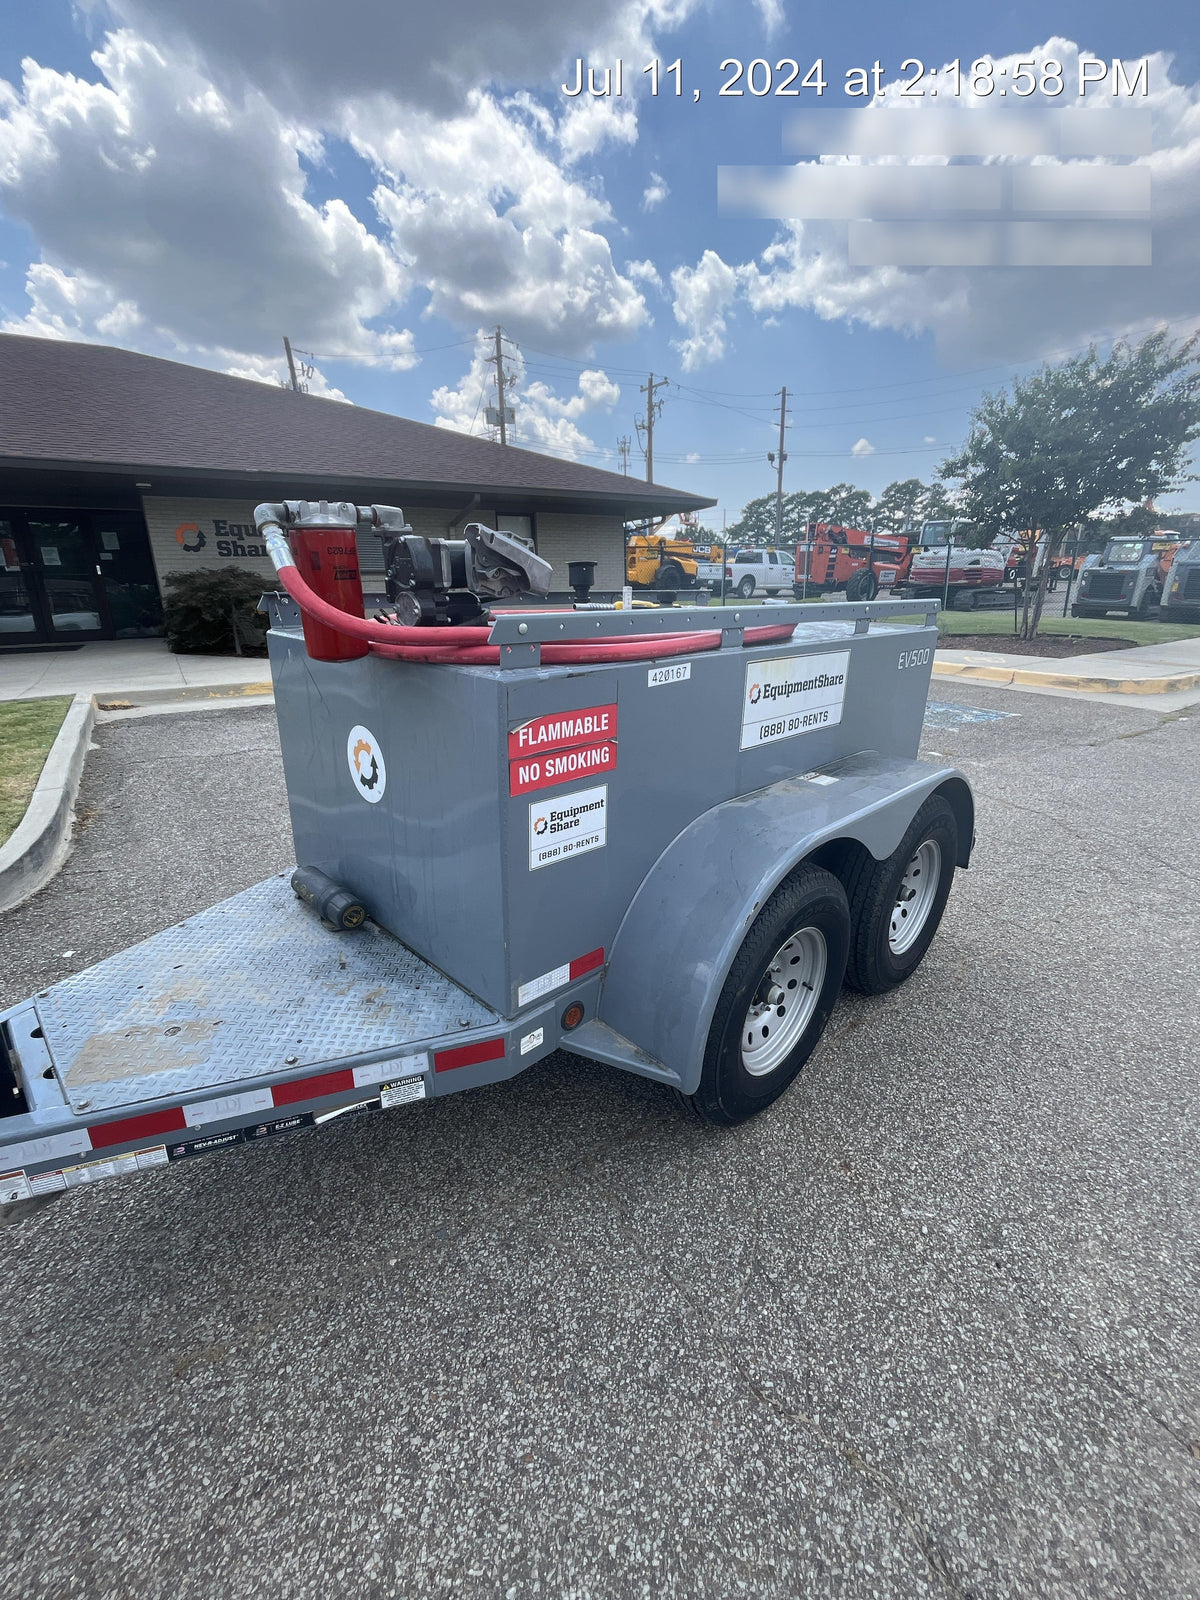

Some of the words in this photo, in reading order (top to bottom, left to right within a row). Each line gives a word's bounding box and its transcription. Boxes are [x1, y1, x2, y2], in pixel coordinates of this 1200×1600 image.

[217, 541, 268, 557] Shar
[692, 545, 712, 554] JCB
[897, 647, 930, 670] EV500
[652, 666, 687, 682] 420167
[762, 674, 844, 700] EquipmentShare
[519, 713, 609, 747] FLAMMABLE
[760, 720, 786, 740] (888)
[788, 711, 829, 731] 80-RENTS
[519, 763, 541, 784] NO
[545, 746, 610, 777] SMOKING
[550, 799, 604, 823] Equipment
[549, 818, 580, 834] Share
[539, 847, 561, 861] (888)
[563, 835, 600, 853] 80-RENTS
[390, 1076, 422, 1088] WARNING
